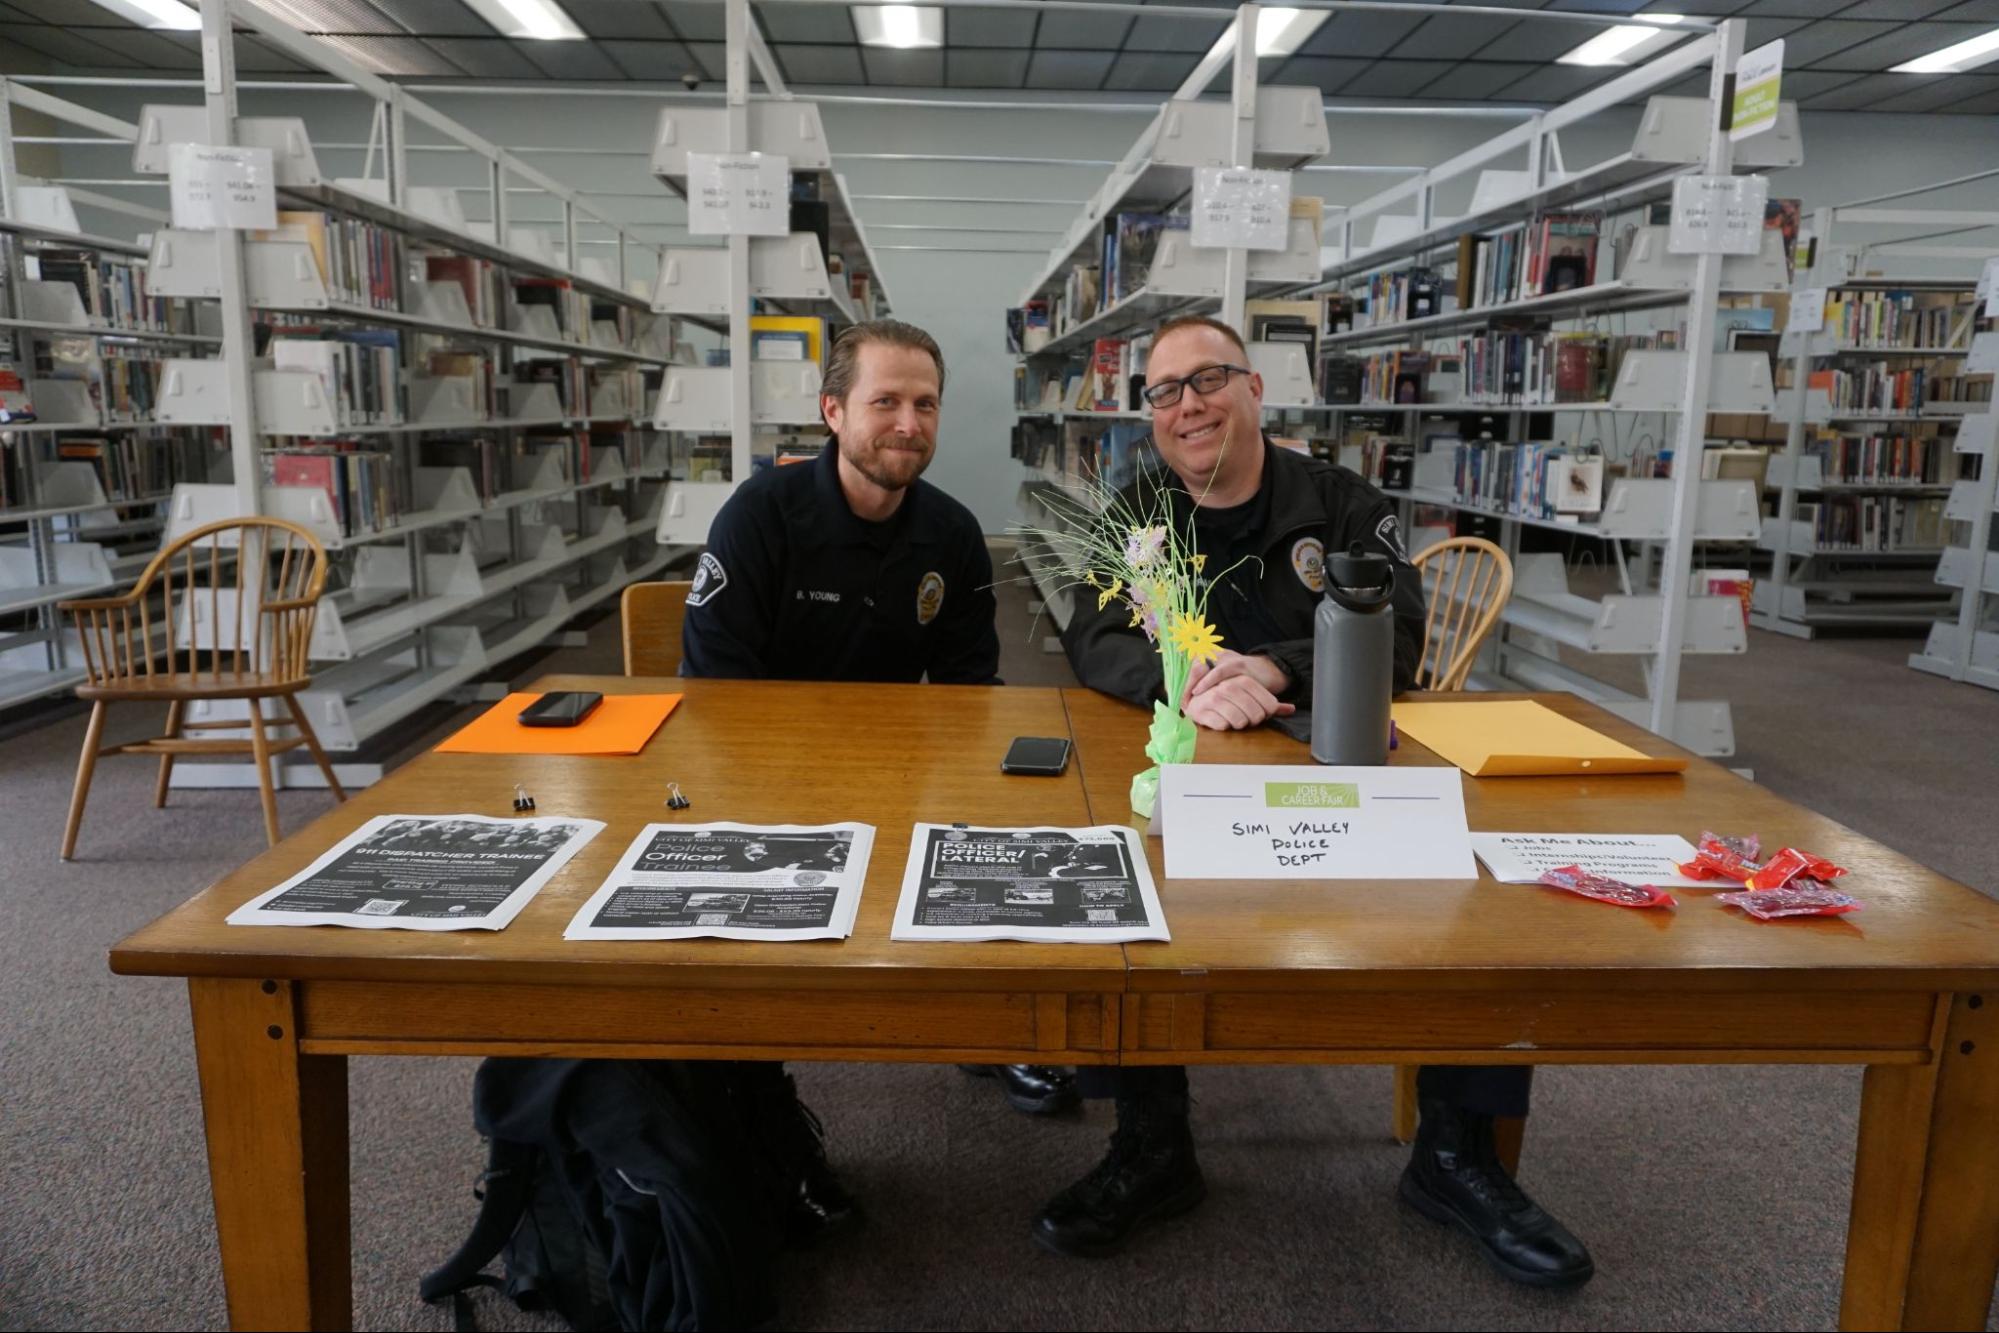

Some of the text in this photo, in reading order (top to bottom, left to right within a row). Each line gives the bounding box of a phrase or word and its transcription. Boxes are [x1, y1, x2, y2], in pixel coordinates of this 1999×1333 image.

[809, 590, 841, 602] YOUNG
[1232, 821, 1351, 836] SIMI VALLEY
[654, 843, 726, 852] Police
[943, 842, 1006, 850] POLICE
[1271, 838, 1330, 851] POLICE
[354, 847, 546, 861] 911 DISPATCHER TRAINEE
[645, 852, 728, 861] Officer
[942, 849, 1026, 858] OFFICER/
[941, 855, 1020, 863] LATERAL
[1277, 853, 1327, 867] DEPT
[640, 861, 731, 871] Trainee
[1594, 860, 1658, 868] Programs
